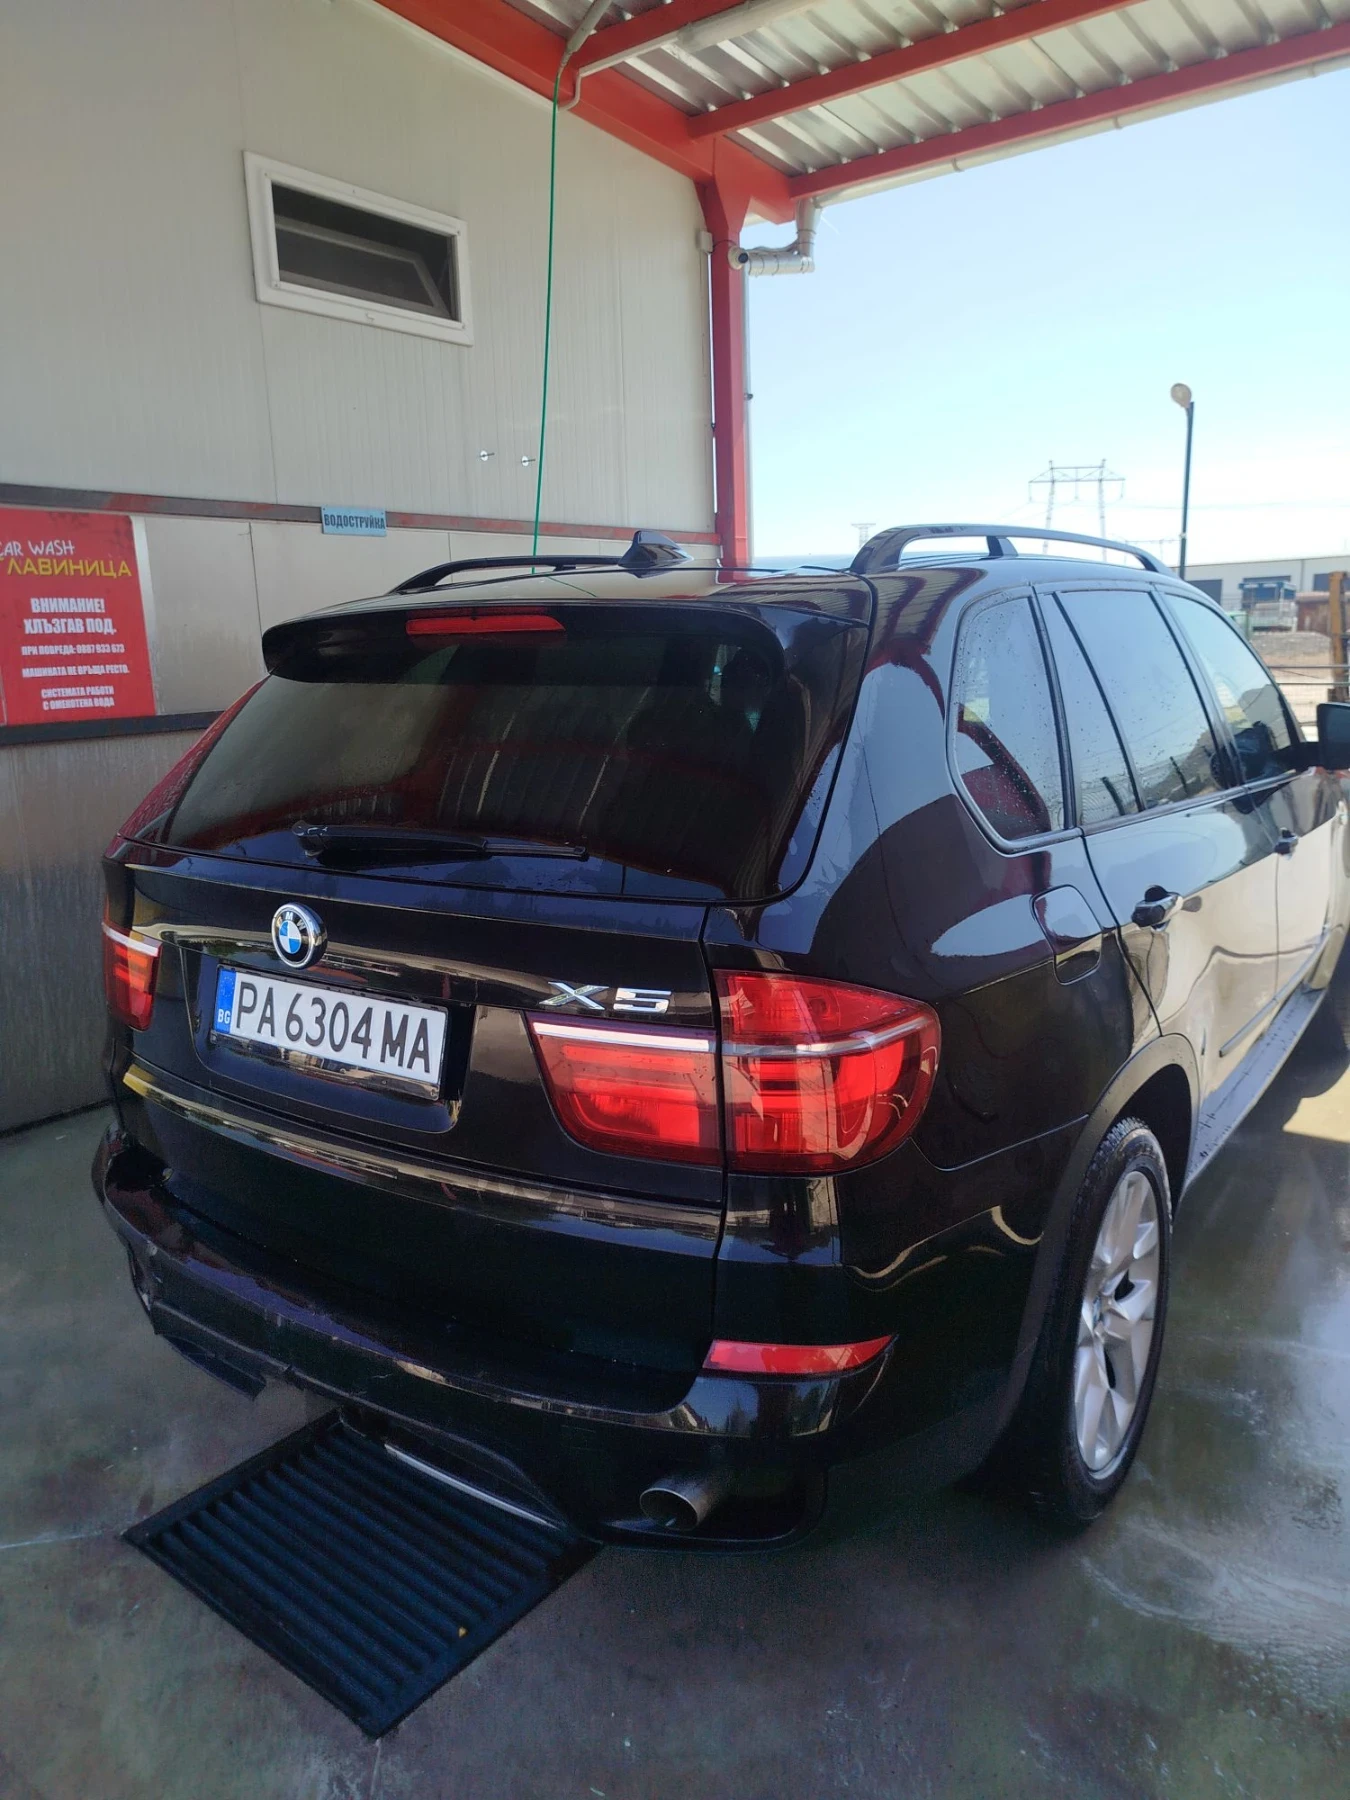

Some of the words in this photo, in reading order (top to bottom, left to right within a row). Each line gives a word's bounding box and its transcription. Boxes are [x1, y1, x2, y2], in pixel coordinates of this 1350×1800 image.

[28, 540, 75, 556] WASH
[0, 558, 132, 578] ЛАВИНИЦА
[31, 598, 105, 613] ВНИМАНИЕ!
[86, 618, 117, 635] ПОД.
[539, 980, 672, 1015] X5
[217, 1008, 231, 1025] BG
